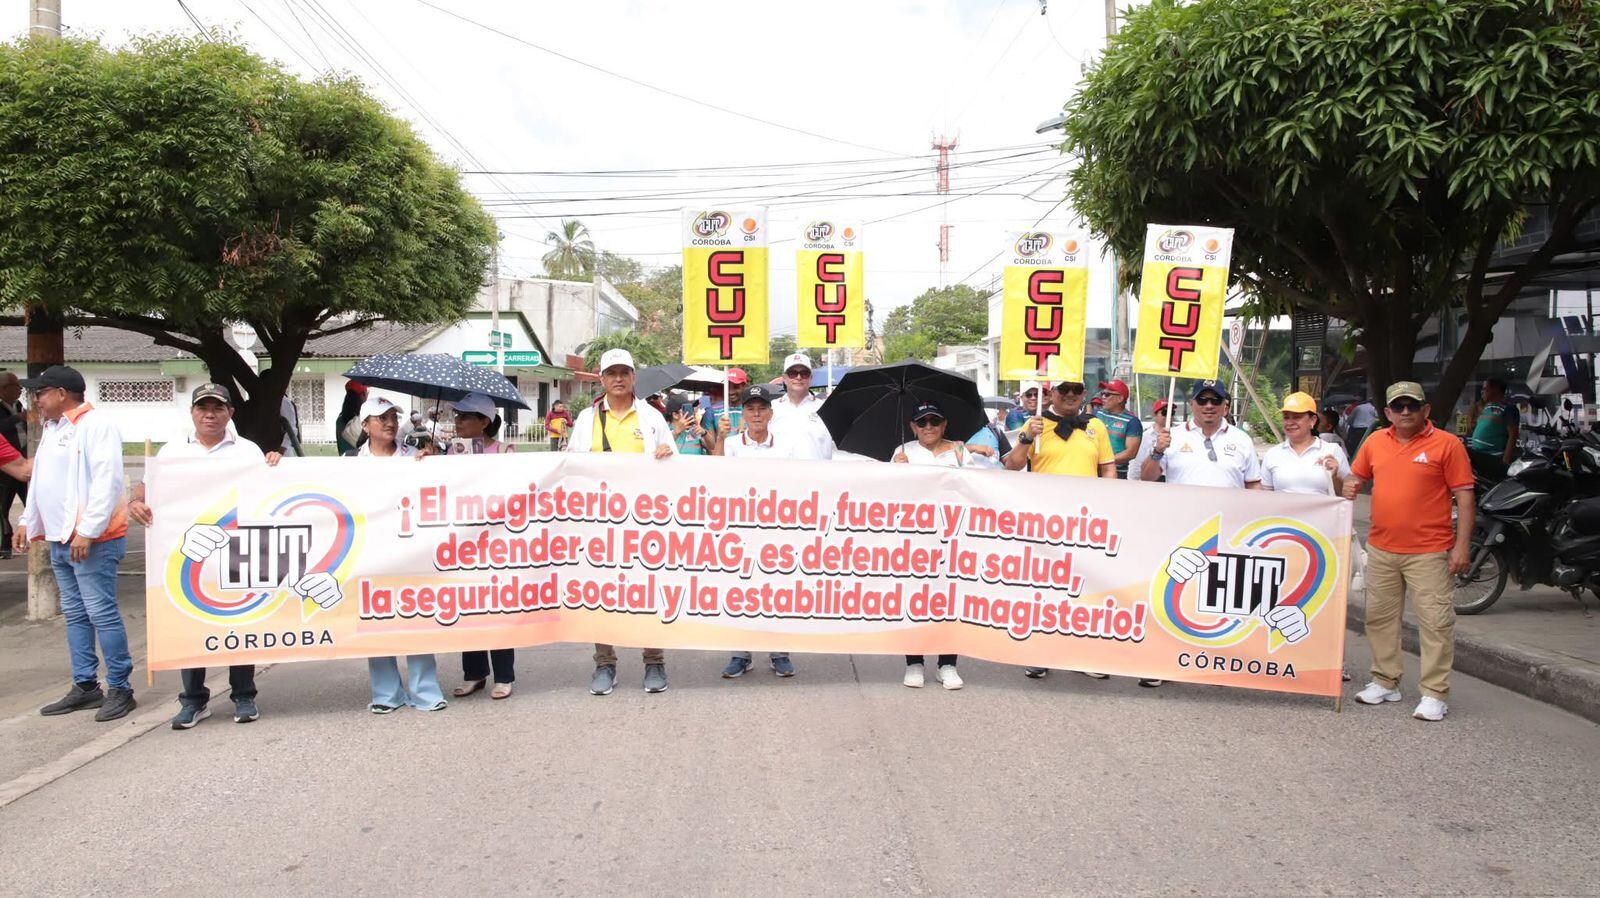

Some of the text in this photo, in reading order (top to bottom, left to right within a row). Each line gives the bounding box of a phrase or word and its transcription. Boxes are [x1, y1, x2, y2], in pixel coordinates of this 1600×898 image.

[743, 234, 756, 242] CSI
[706, 250, 746, 360] CUT
[815, 253, 847, 344] CUT
[1024, 269, 1065, 377] CUT
[1159, 266, 1204, 373] CUT
[455, 482, 628, 530] magisterio
[635, 491, 671, 522] es
[676, 485, 828, 533] dignidad,
[836, 491, 936, 531] fuerza
[943, 503, 964, 537] y
[970, 503, 1119, 551] memoria,
[435, 528, 1081, 592] defender el FOMAG, es defender la salud,
[361, 573, 1145, 639] la seguridad social y la estabilidad del magisterio!
[204, 629, 334, 652] CÓRDOBA
[1177, 650, 1297, 679] CÓRDOBA
